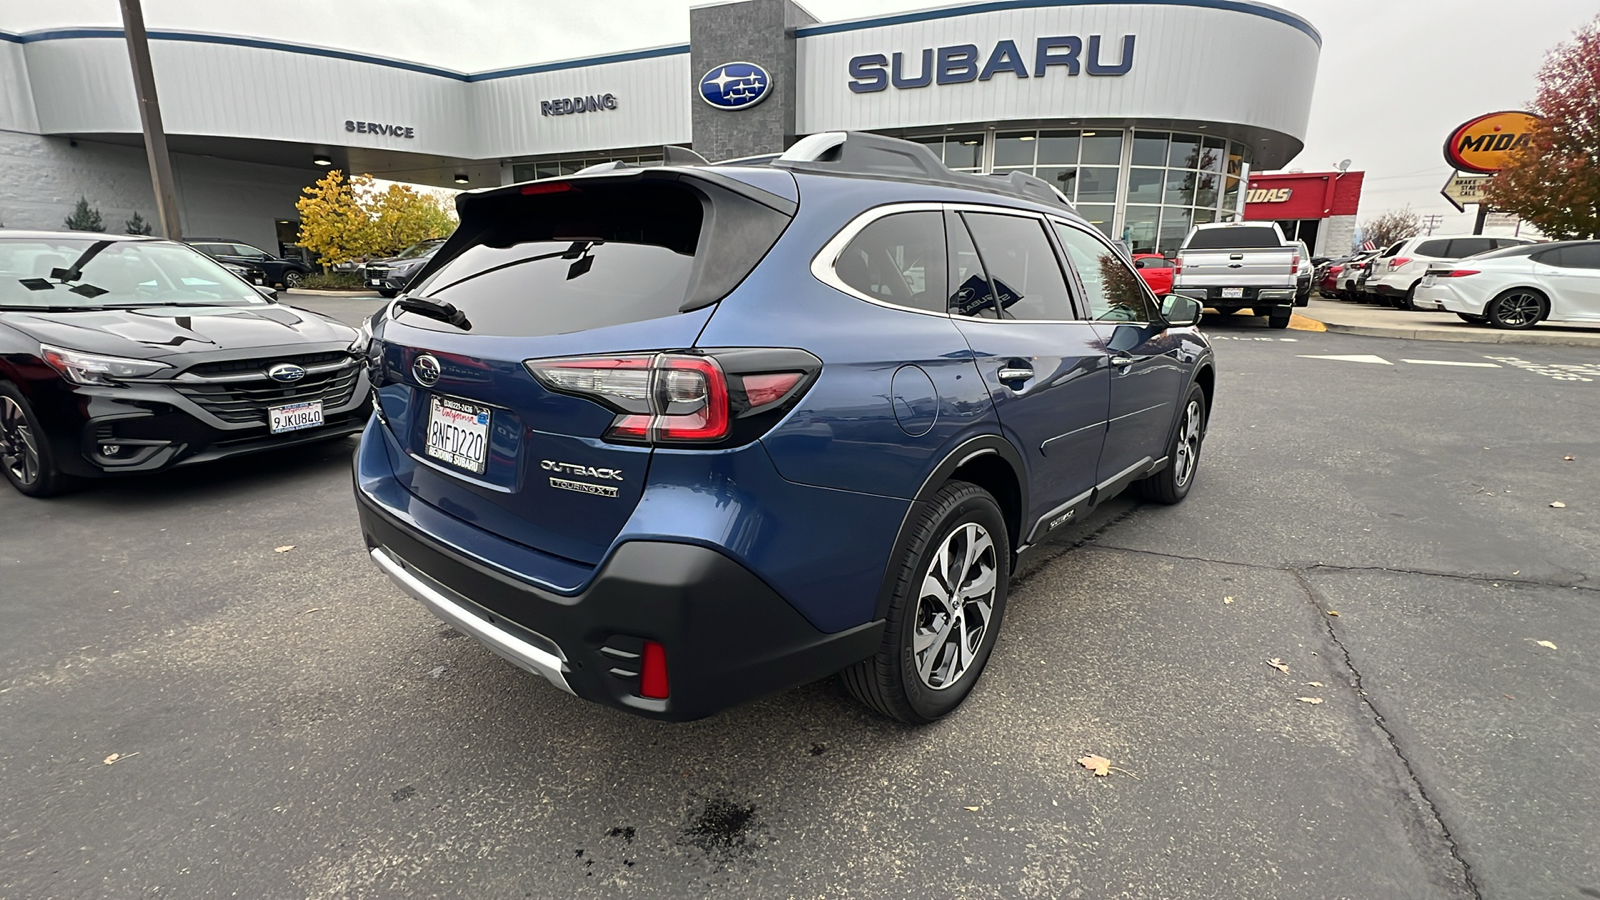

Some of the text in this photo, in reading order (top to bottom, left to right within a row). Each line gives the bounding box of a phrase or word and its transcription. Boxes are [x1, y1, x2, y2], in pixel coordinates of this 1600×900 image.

[848, 34, 1136, 93] SUBARU
[540, 93, 617, 116] REDDING
[345, 119, 415, 138] SERVICE
[1458, 126, 1532, 154] MIDA
[1246, 183, 1293, 204] IDAS
[274, 411, 320, 428] 9JKU840
[441, 407, 478, 425] California
[431, 420, 483, 461] 8NFD220
[428, 446, 479, 473] REDDING SUBARU
[540, 459, 624, 481] OUTBACK
